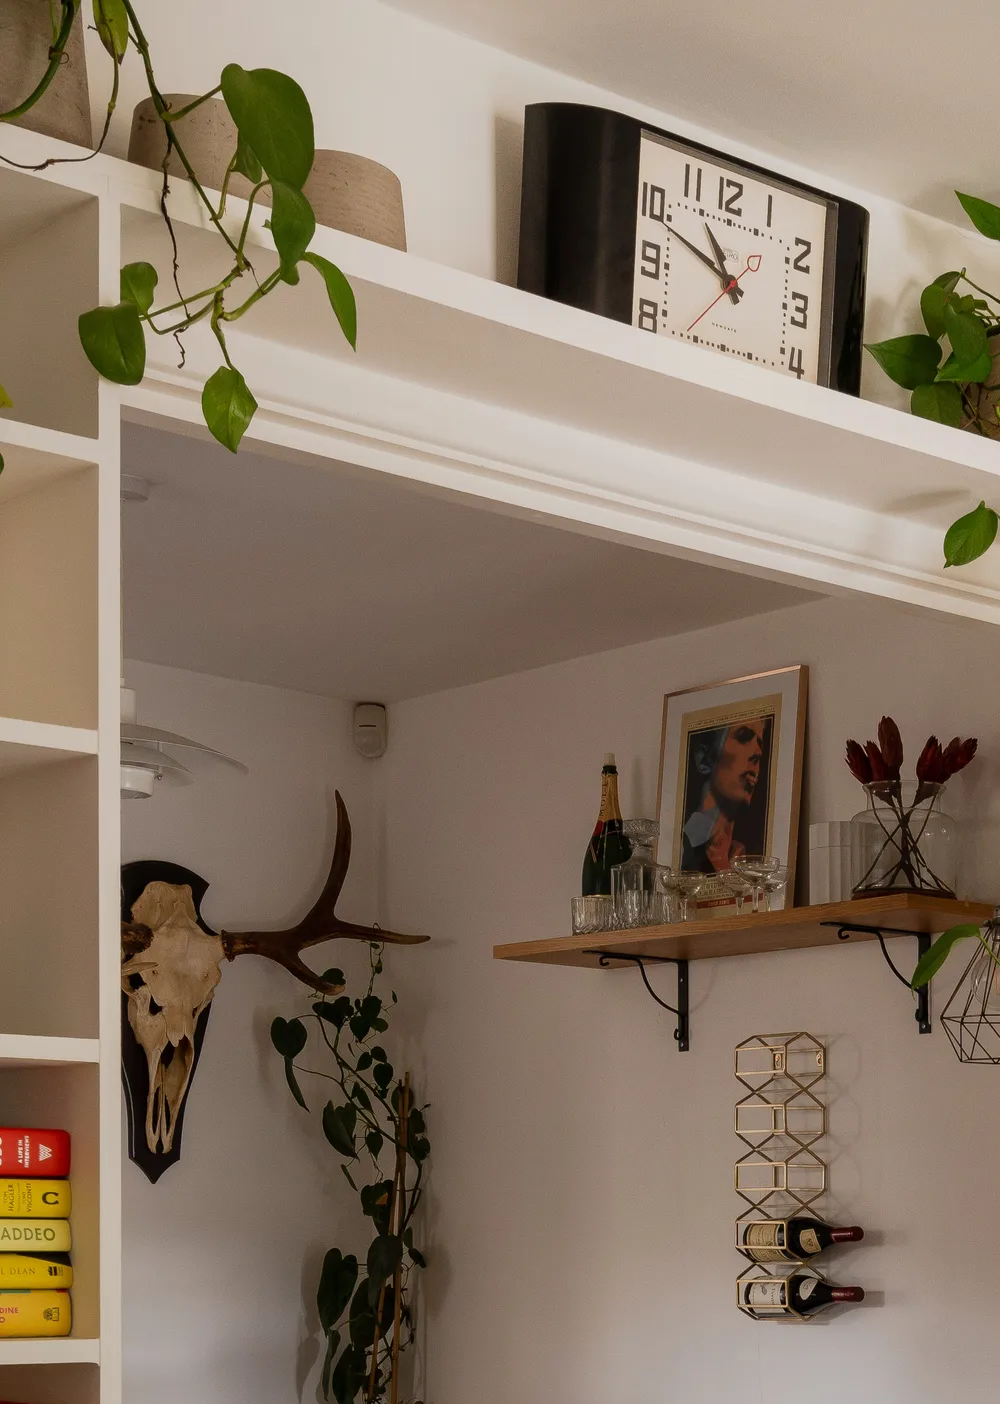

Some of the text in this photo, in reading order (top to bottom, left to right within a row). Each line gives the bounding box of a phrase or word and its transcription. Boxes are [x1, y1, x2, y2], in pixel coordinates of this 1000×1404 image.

[683, 163, 702, 203] 11
[718, 176, 744, 217] 12
[641, 182, 665, 222] 10
[766, 194, 772, 228] 1
[641, 240, 662, 280] 9
[793, 237, 812, 274] 2
[638, 298, 658, 334] 8
[712, 322, 737, 334] NEWGATE
[790, 292, 808, 330] 3
[788, 346, 804, 380] 4
